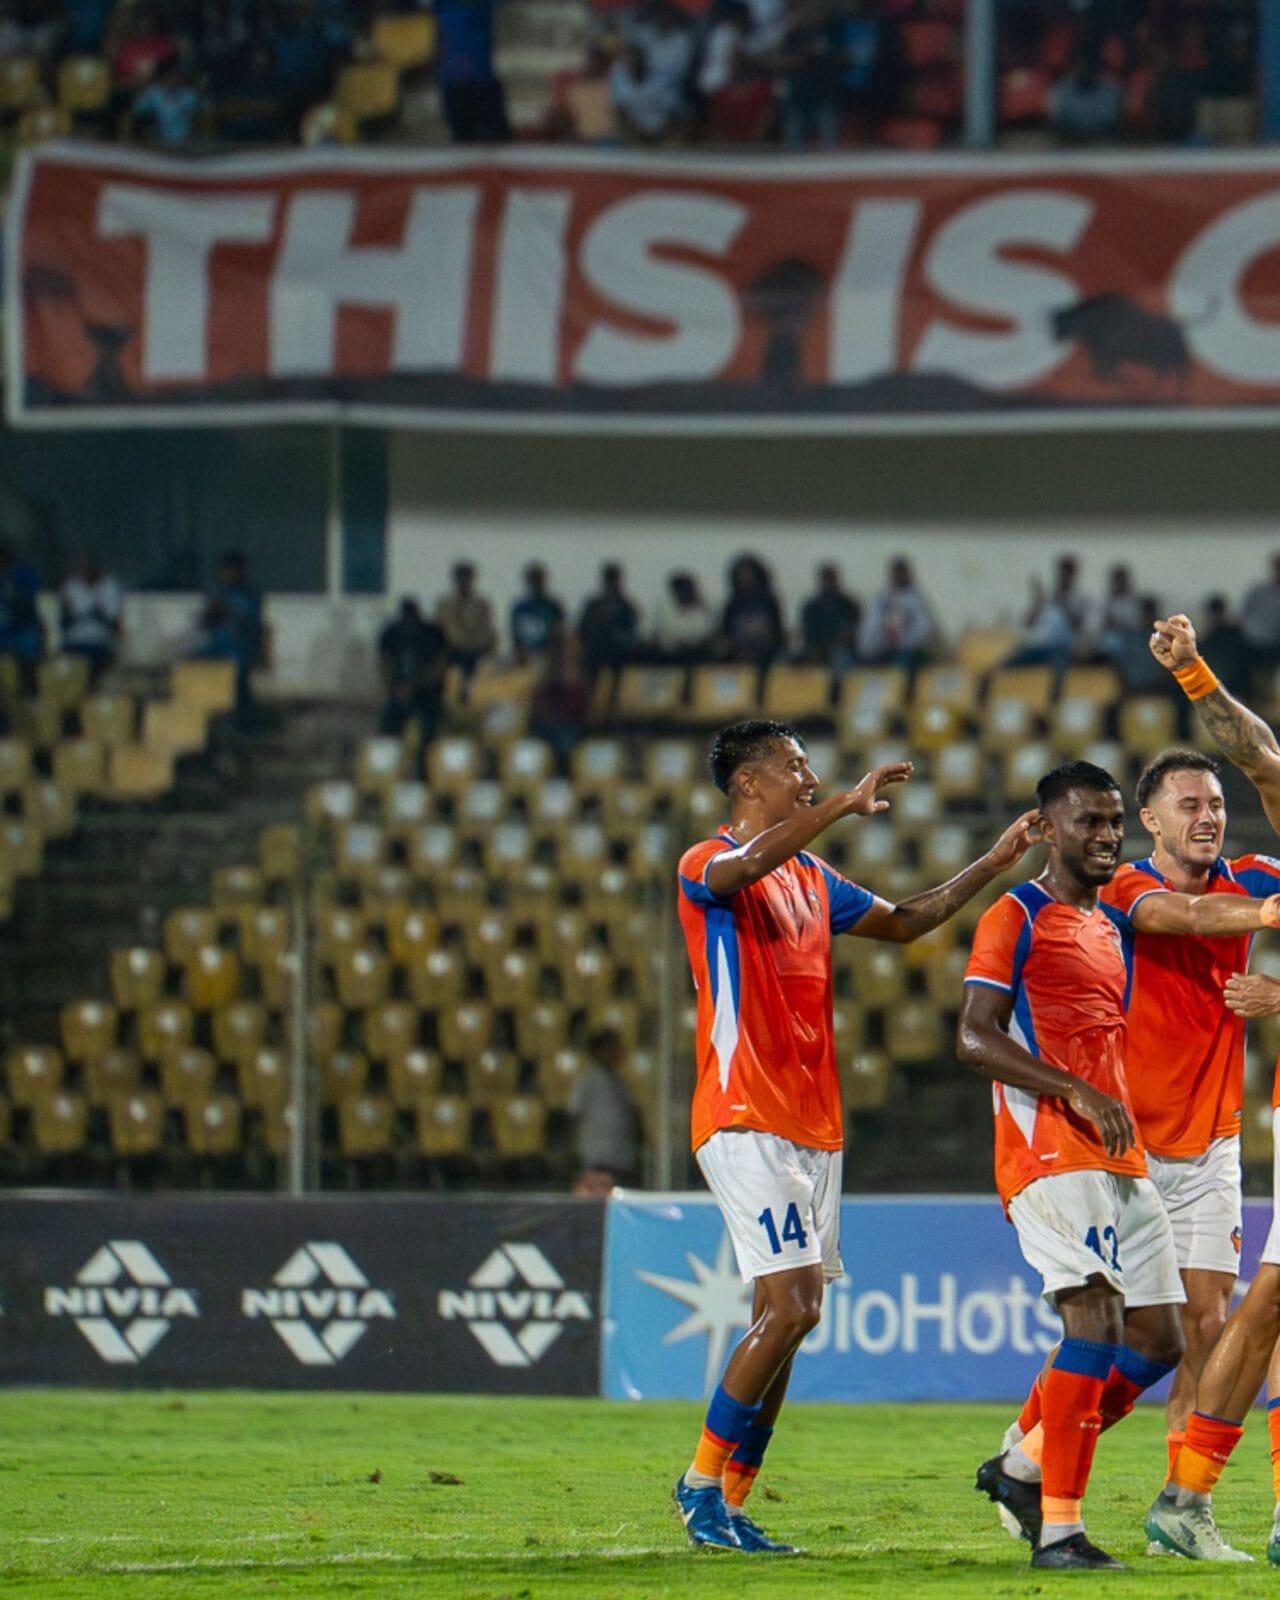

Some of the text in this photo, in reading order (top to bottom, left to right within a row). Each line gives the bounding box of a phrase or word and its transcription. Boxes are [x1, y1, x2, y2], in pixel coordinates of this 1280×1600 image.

[98, 182, 746, 386] THIS
[829, 194, 1091, 388] IS
[758, 1201, 808, 1254] 14
[45, 1287, 199, 1317] NIVIA
[242, 1287, 397, 1317] NIVIA
[438, 1288, 592, 1319] NIVIA
[800, 1273, 1066, 1355] JioHots
